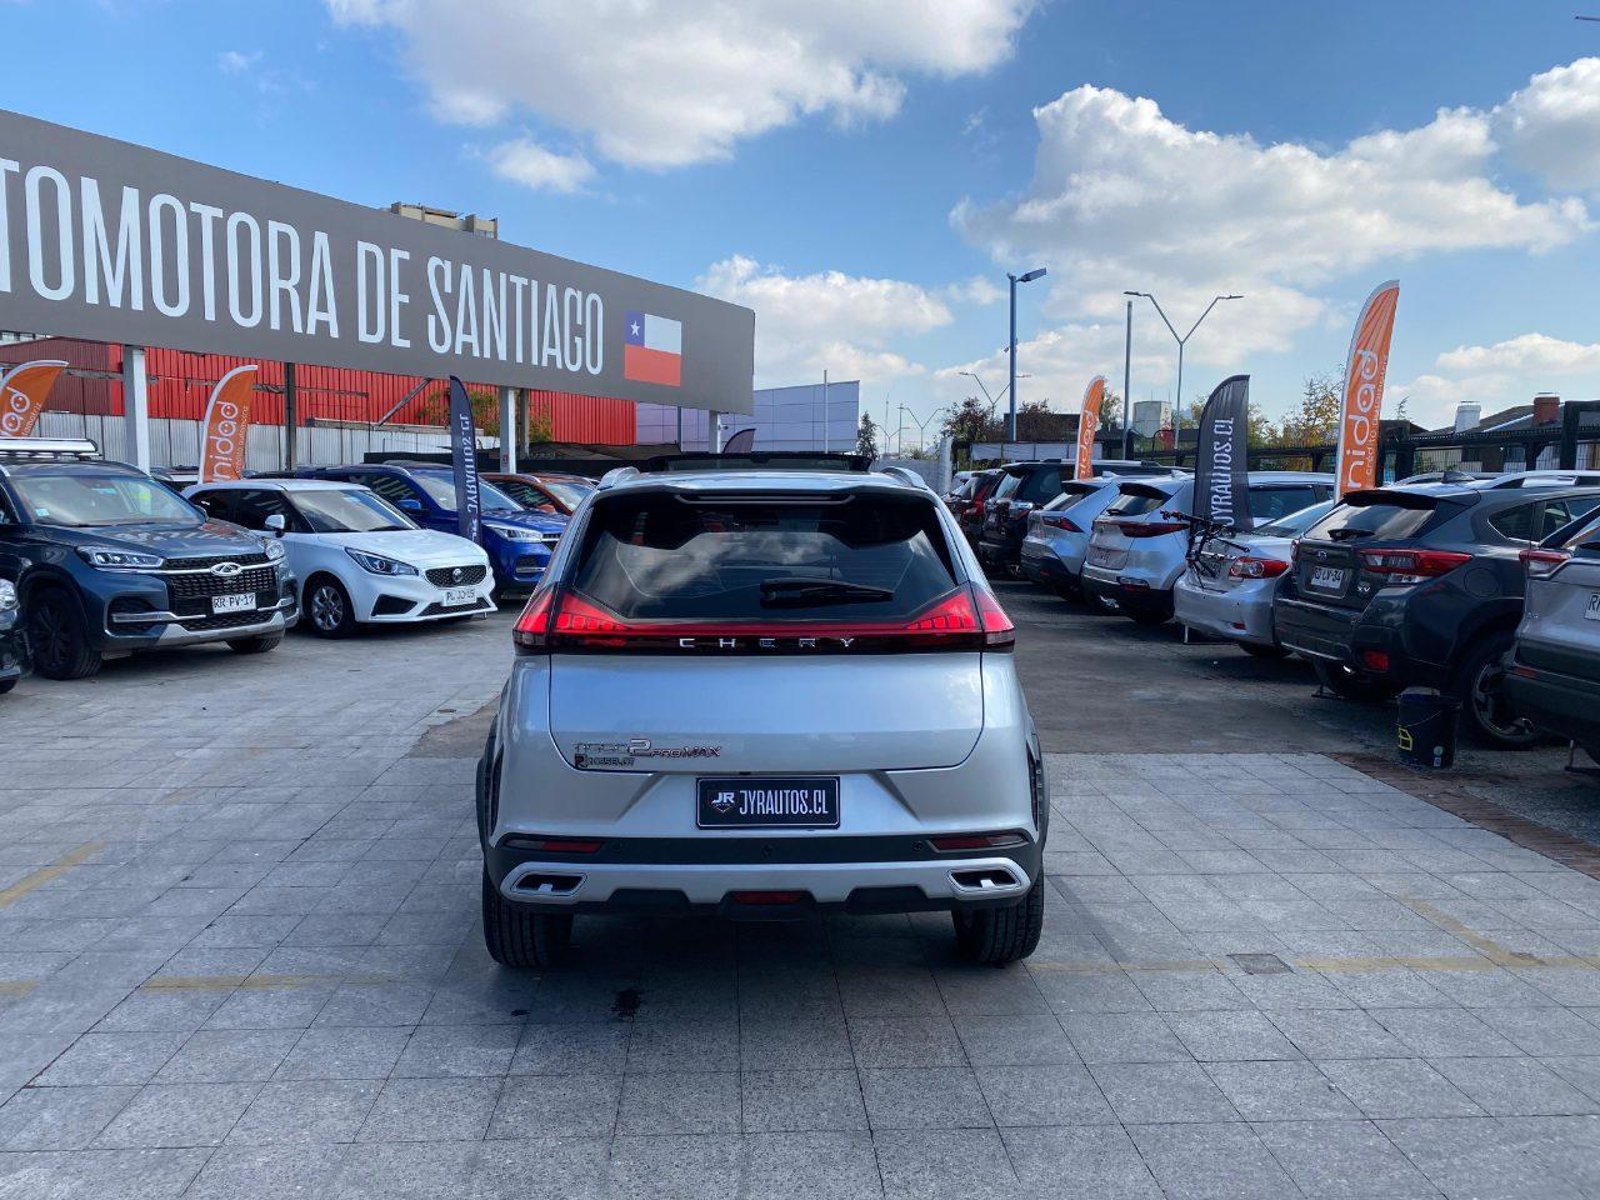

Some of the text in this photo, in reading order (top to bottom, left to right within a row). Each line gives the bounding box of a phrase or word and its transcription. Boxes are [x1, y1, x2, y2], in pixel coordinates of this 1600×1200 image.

[357, 240, 411, 348] DE
[427, 255, 604, 375] SANTIAGO
[1210, 417, 1235, 526] JYRAUTOS.CL
[679, 638, 855, 648] CHERY
[711, 790, 828, 814] JR JYRAUTOS.CL
